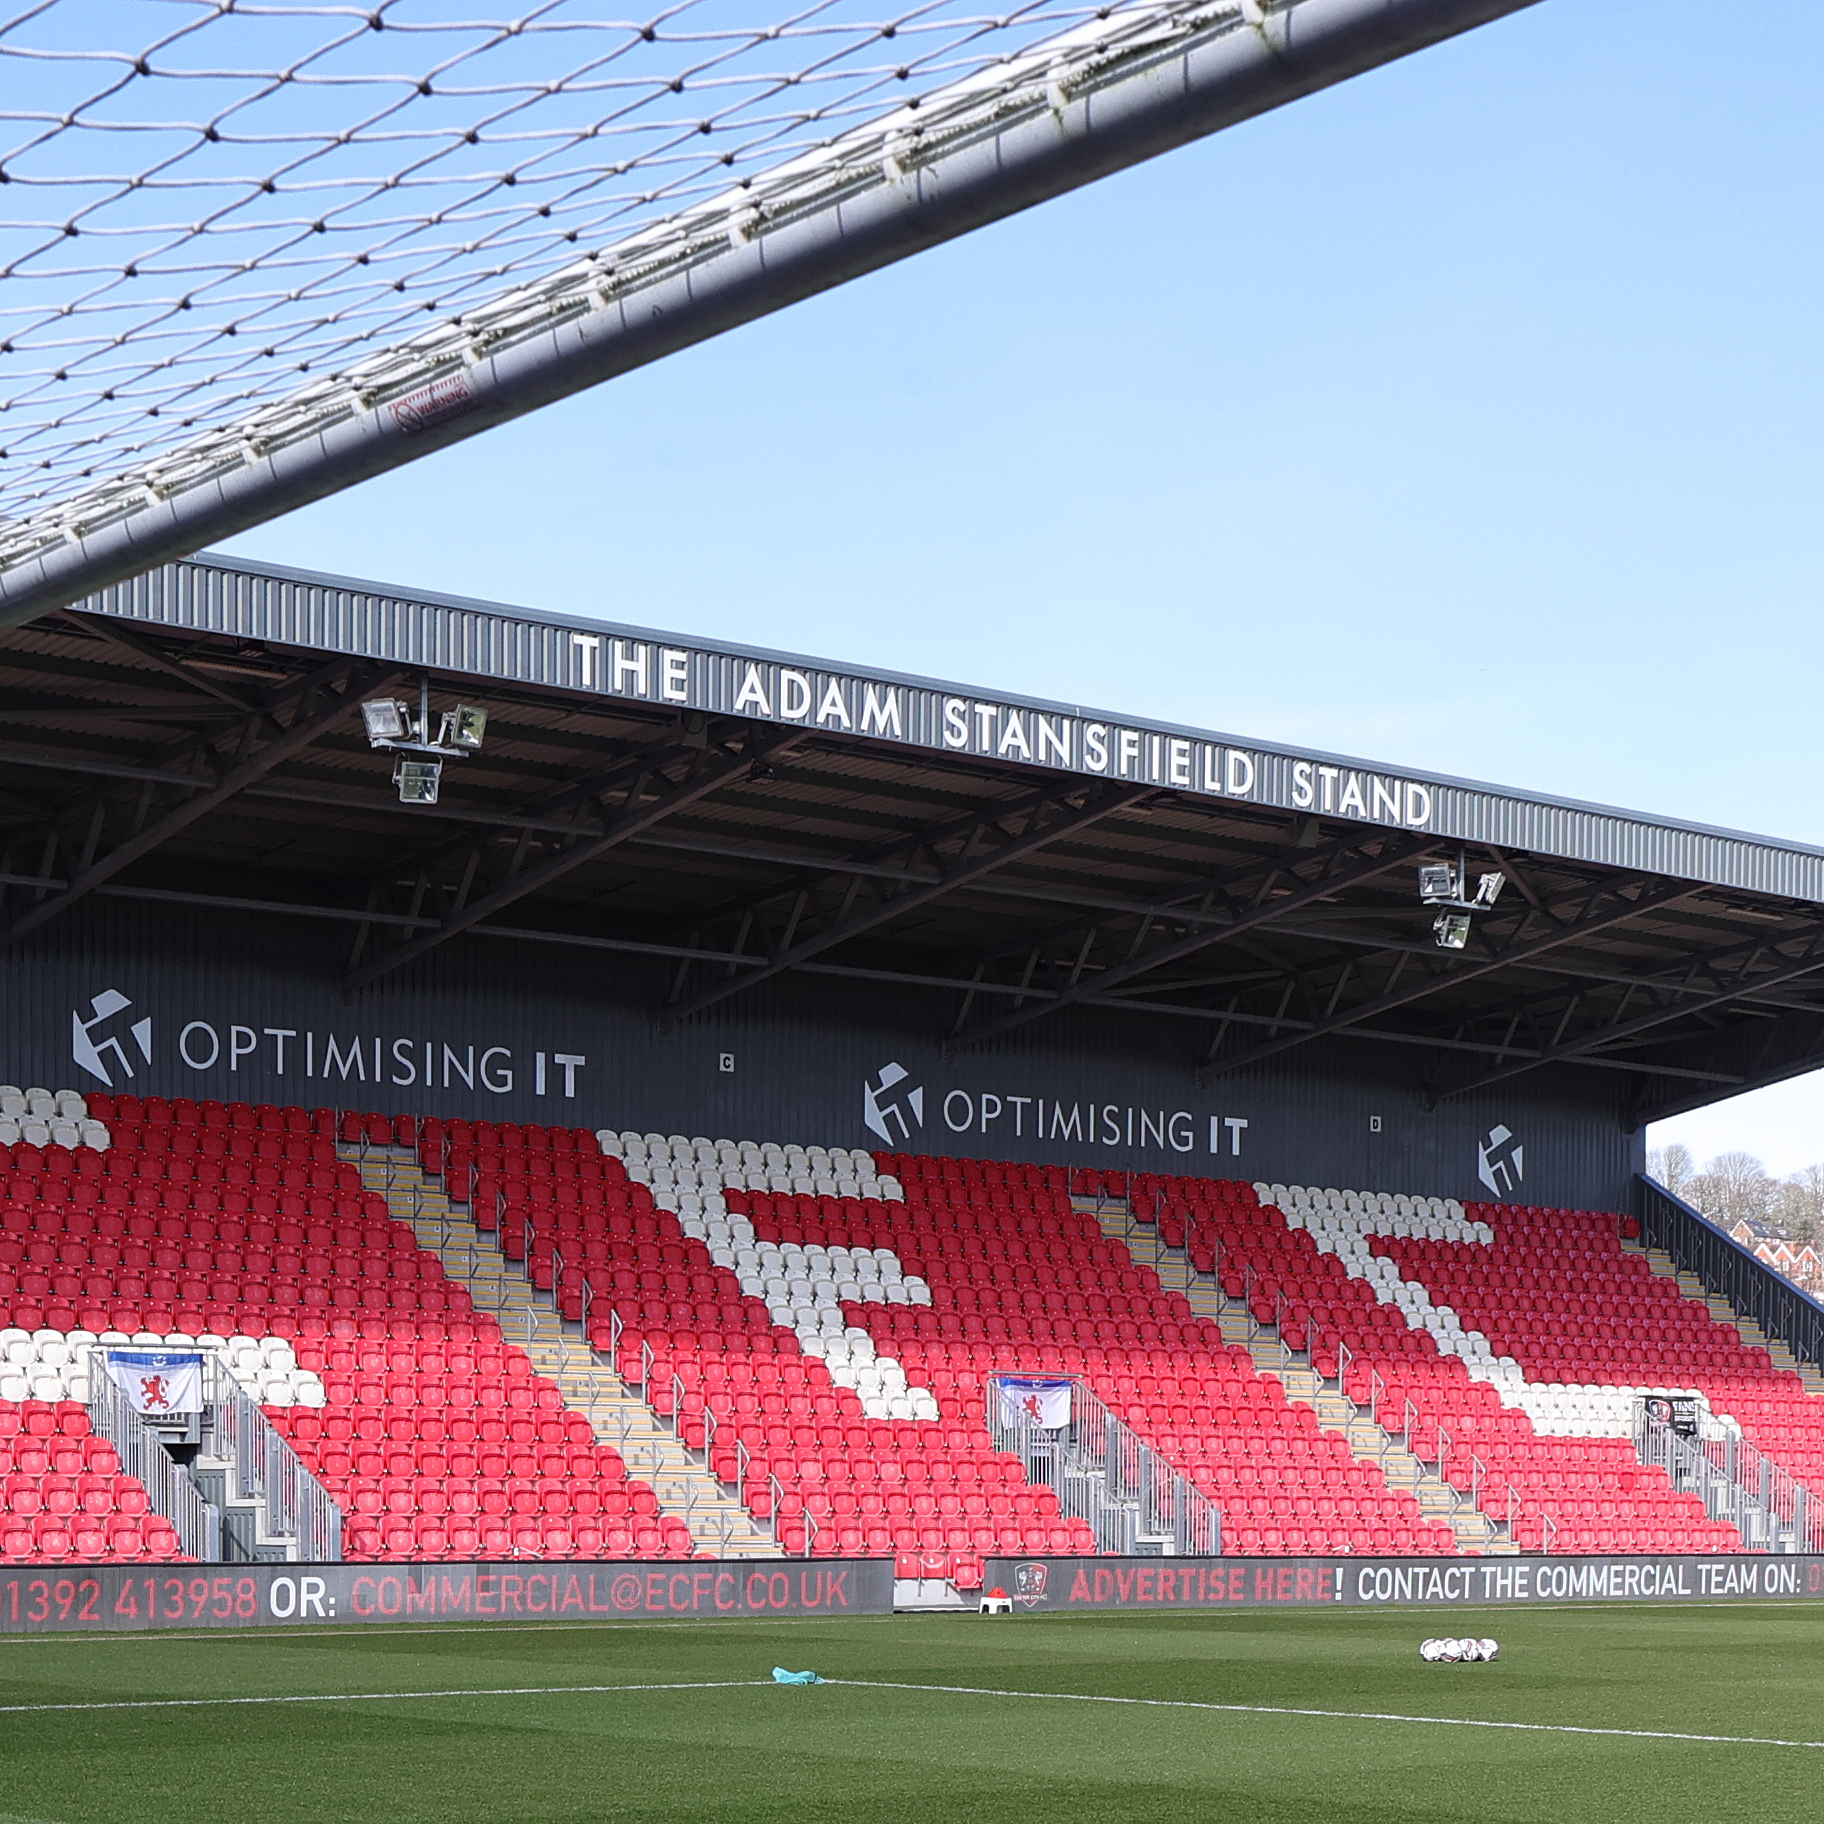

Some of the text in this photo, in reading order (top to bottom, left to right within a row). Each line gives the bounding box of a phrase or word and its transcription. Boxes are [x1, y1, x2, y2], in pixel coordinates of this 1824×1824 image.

[572, 634, 1433, 828] THE ADAM STANSFIELD STAND
[179, 1019, 586, 1098] OPTIMISING IT
[723, 1056, 731, 1069] C
[943, 1089, 1249, 1156] OPTIMISING IT
[114, 1576, 258, 1620] 413958
[269, 1575, 337, 1619] OR:
[350, 1570, 849, 1618] COMMERCIAL@ECFC.CO.UK
[1069, 1567, 1250, 1604] ADVERTISE
[1254, 1566, 1343, 1602] HERE!
[1358, 1565, 1475, 1601] CONTACT
[1480, 1565, 1530, 1600] THE
[1535, 1563, 1693, 1599] COMMERCIAL
[1697, 1562, 1759, 1596] TEAM
[1764, 1561, 1801, 1595] ON:
